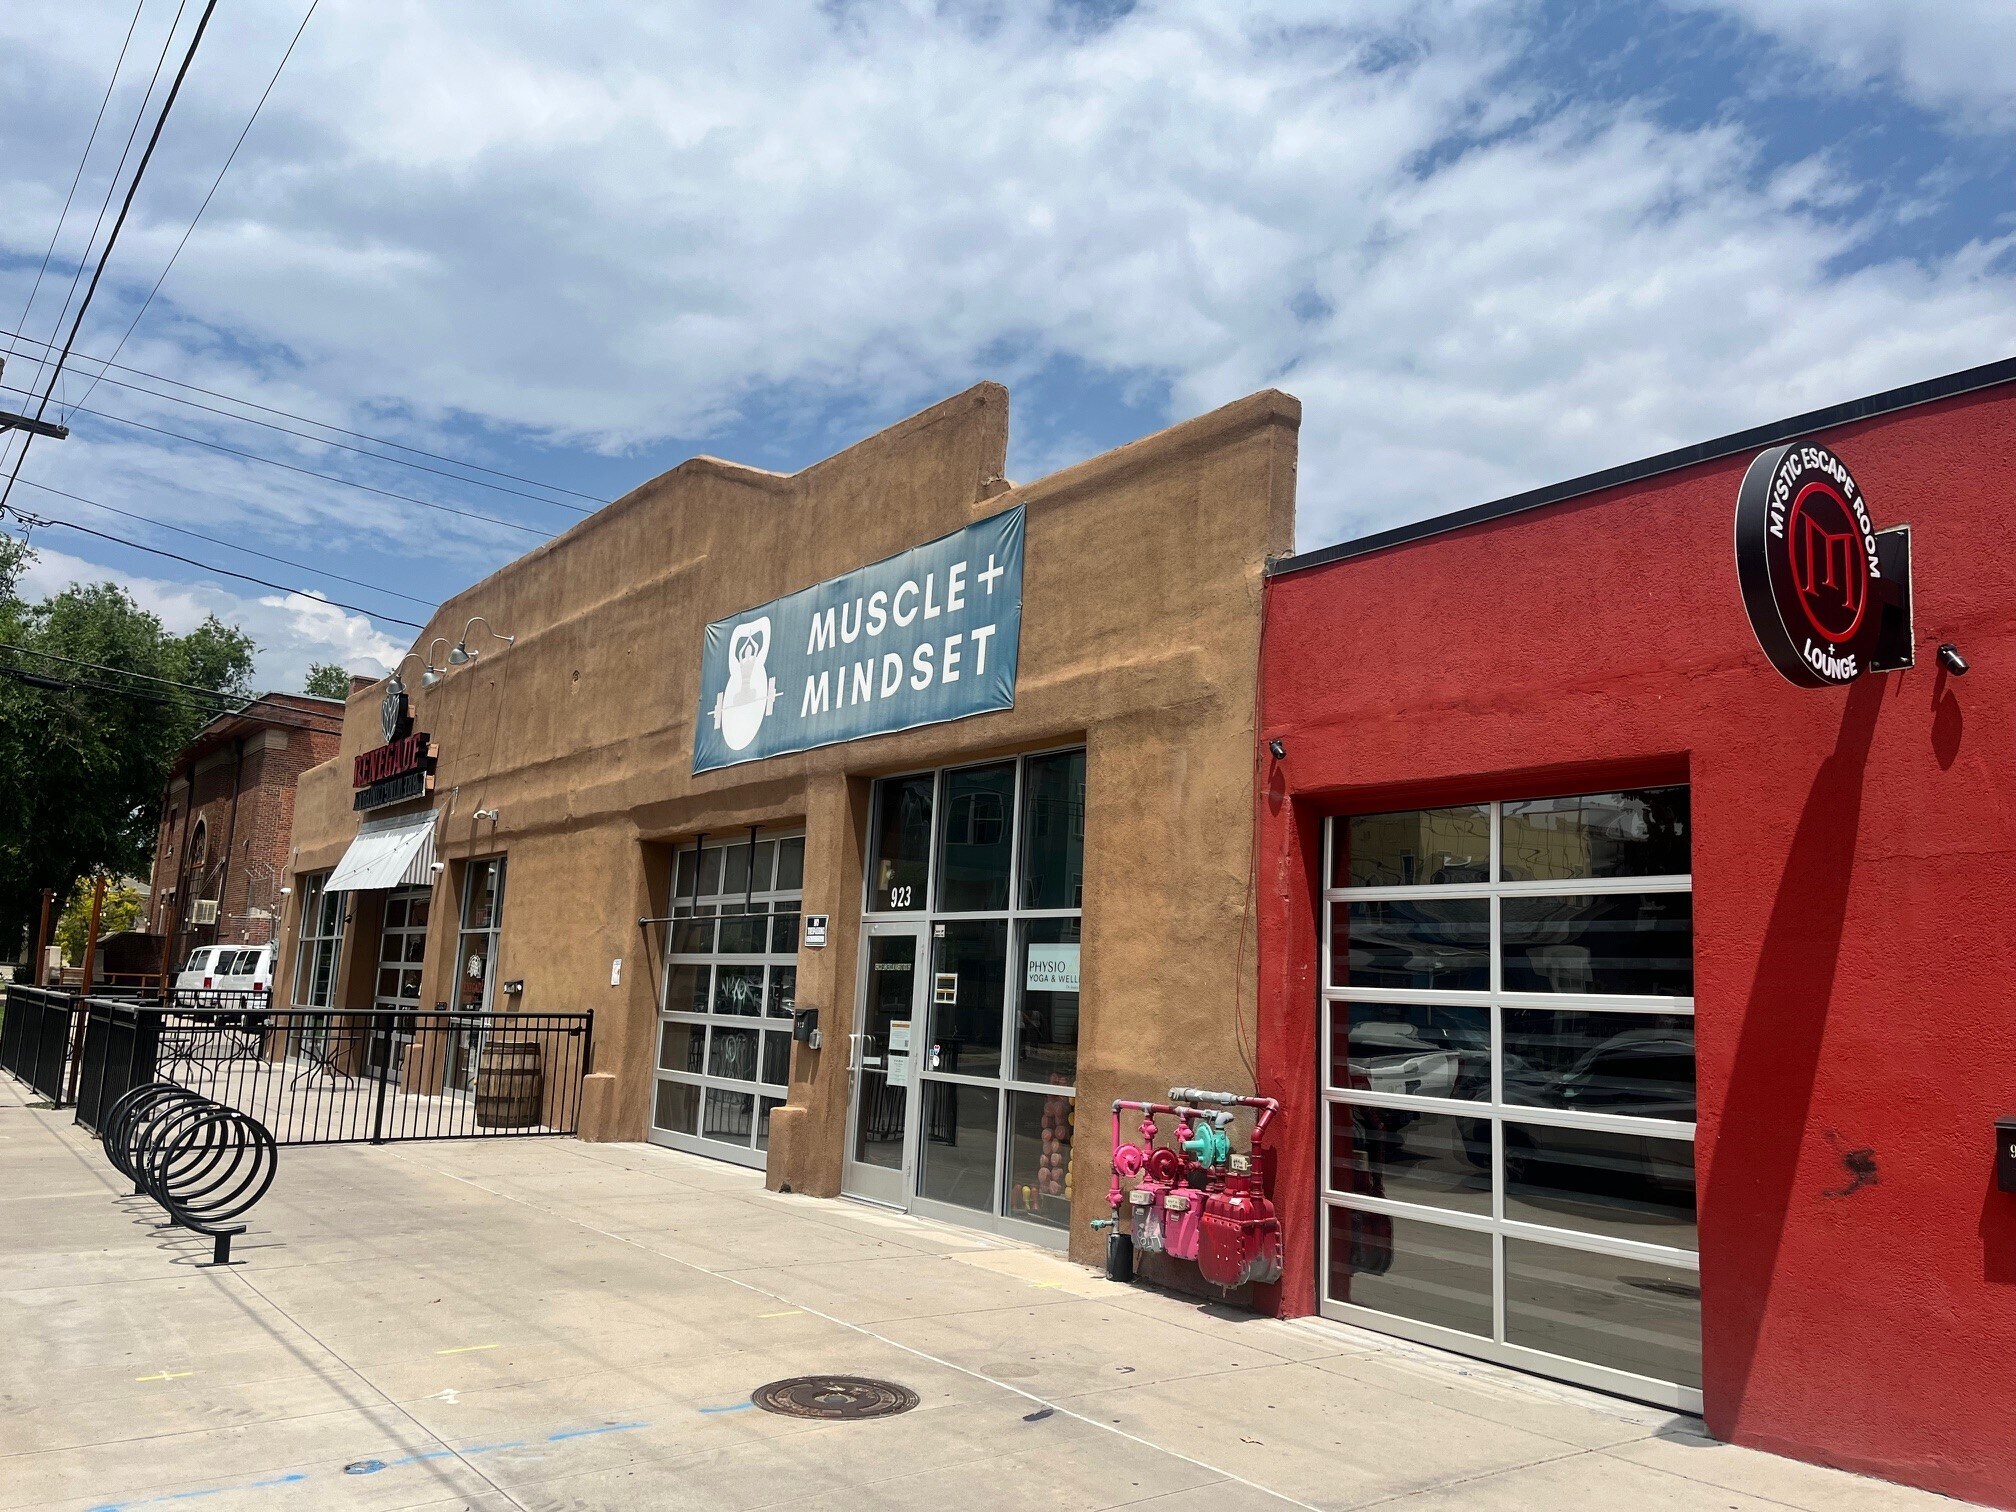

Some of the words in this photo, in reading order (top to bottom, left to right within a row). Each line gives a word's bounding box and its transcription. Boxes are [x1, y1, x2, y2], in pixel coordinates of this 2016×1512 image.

[1769, 453, 1802, 539] MYSTIC
[1801, 447, 1855, 499] ESCAPE
[1853, 496, 1881, 578] ROOM
[806, 560, 968, 655] MUSCLE
[800, 623, 996, 718] MINDSET
[1803, 638, 1858, 680] LOUNGE
[353, 732, 422, 788] RENEGADE
[890, 885, 912, 908] 923
[1029, 960, 1066, 973] PHYSIO
[1029, 974, 1049, 983] YOGA
[1051, 974, 1056, 983] &
[1059, 974, 1081, 984] WELL
